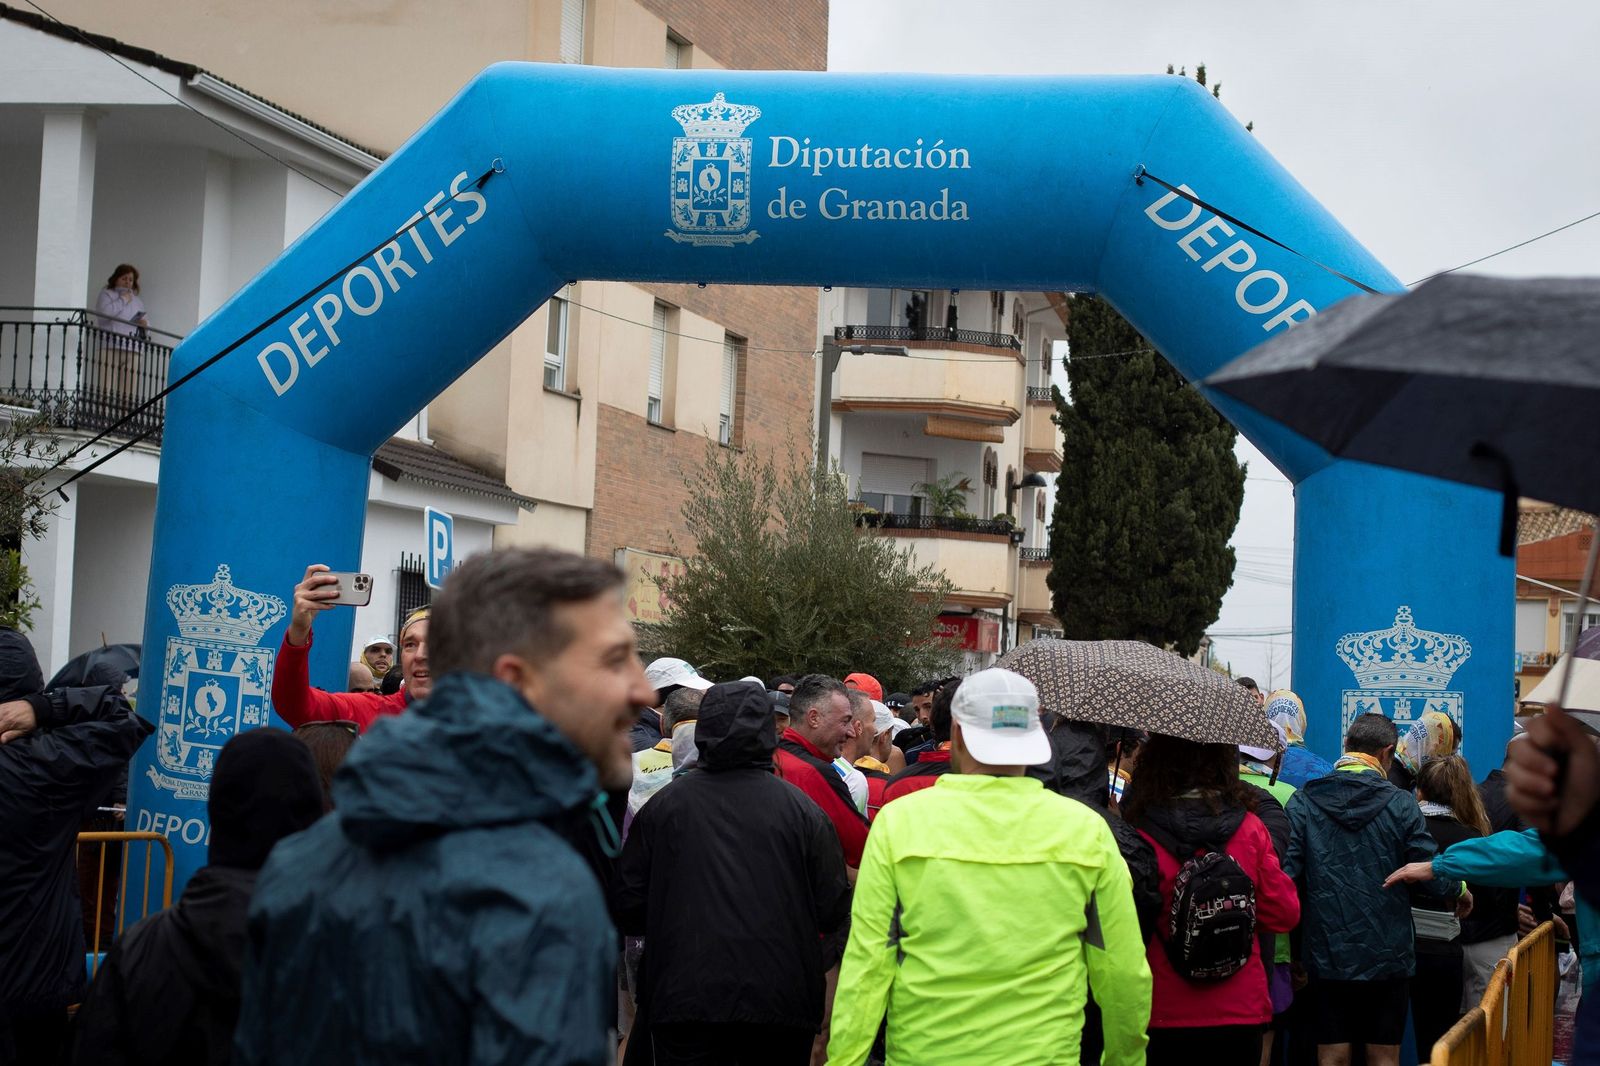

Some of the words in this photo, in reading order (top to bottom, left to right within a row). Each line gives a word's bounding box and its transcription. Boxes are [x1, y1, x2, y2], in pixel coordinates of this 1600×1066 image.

[768, 136, 971, 176] Diputación
[767, 186, 807, 220] de
[818, 187, 970, 221] Granada
[256, 170, 488, 398] DEPORTES
[432, 518, 449, 579] P
[181, 787, 209, 798] GRAN
[136, 808, 211, 847] DEPO
